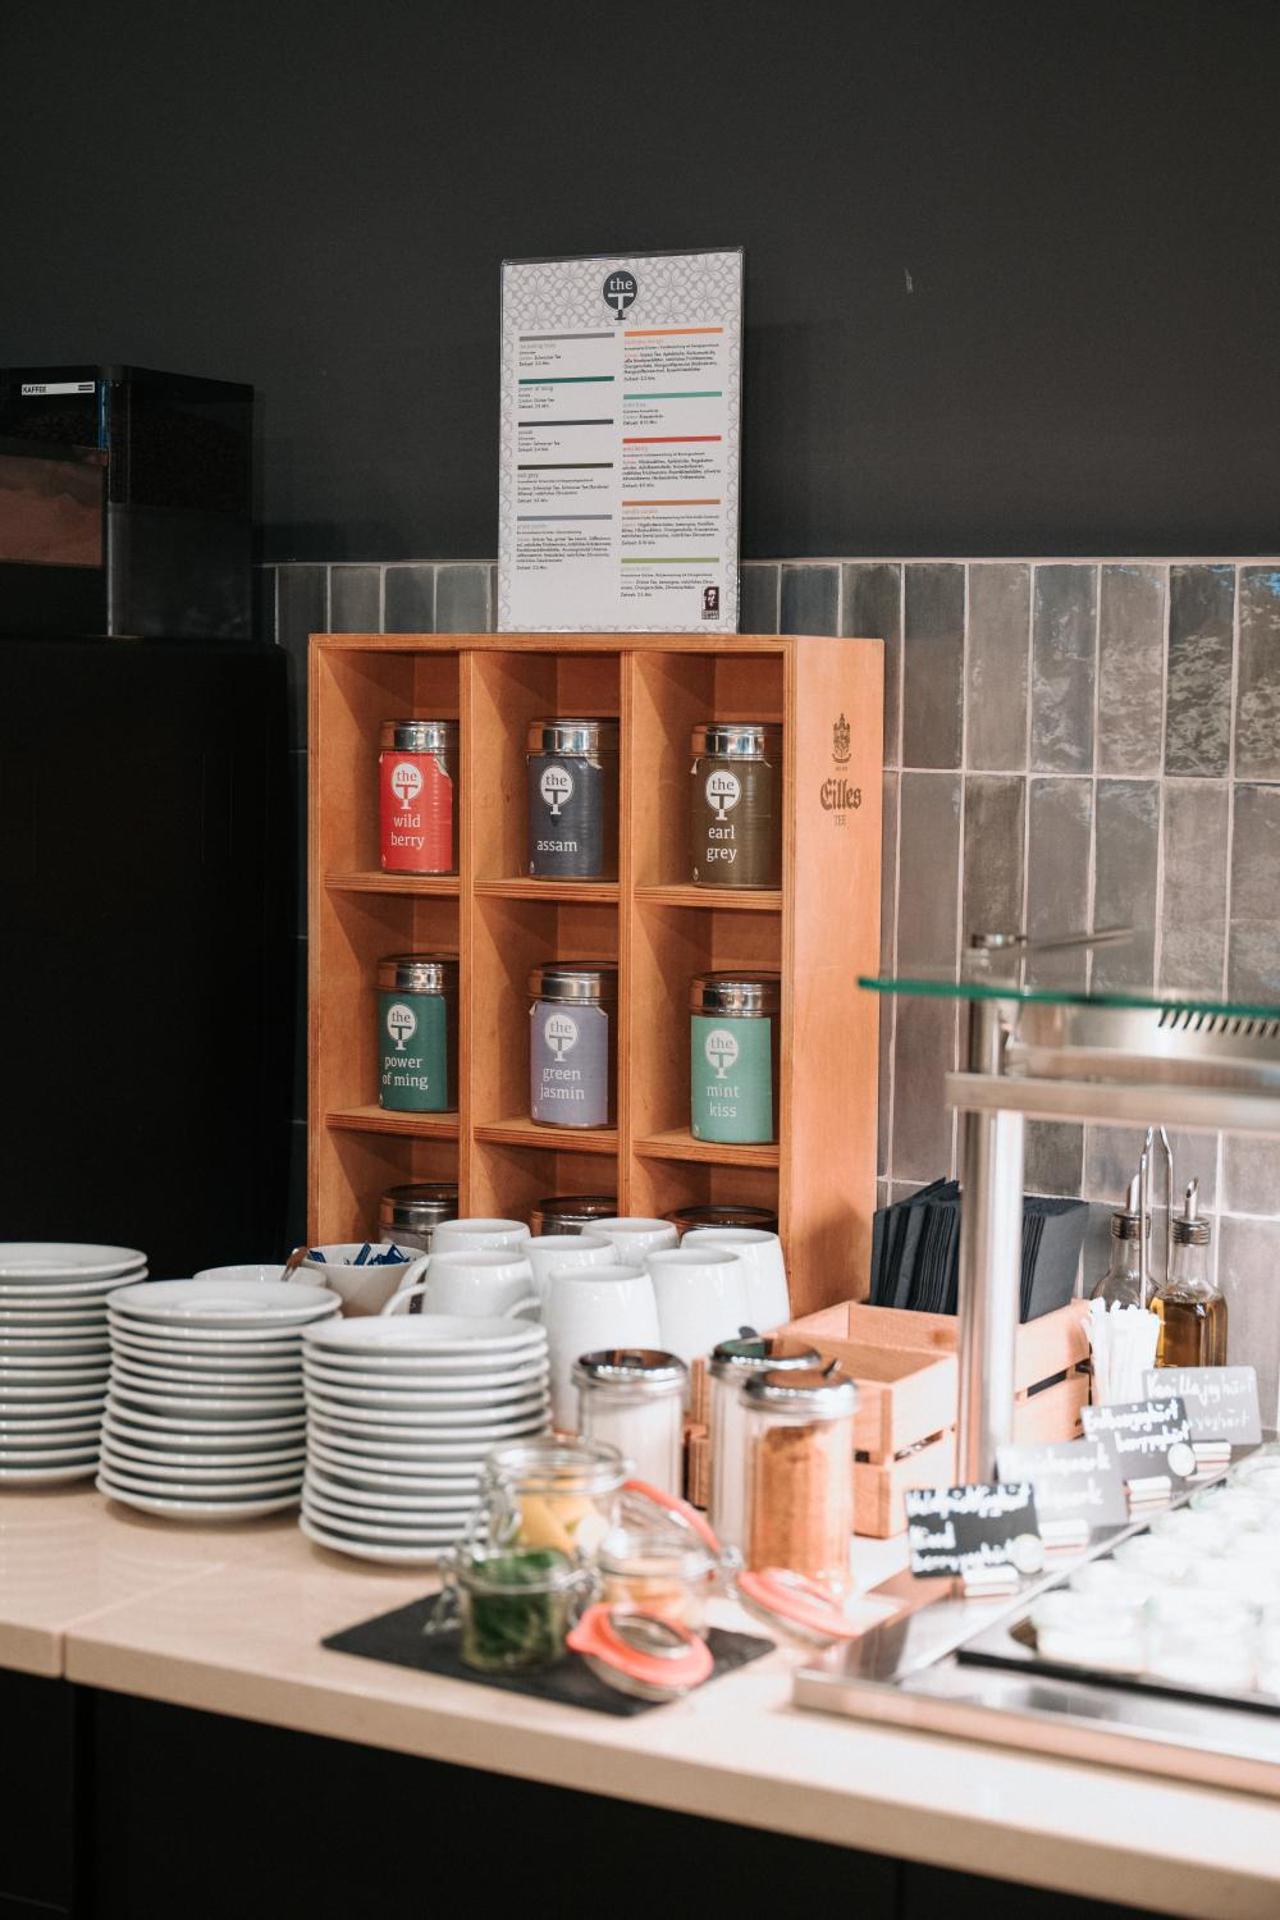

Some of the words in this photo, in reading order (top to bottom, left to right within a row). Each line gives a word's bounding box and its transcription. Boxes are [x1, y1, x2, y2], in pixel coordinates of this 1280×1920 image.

[610, 277, 634, 291] the
[22, 385, 47, 394] KAFFEE
[396, 767, 417, 783] the
[545, 773, 568, 787] the
[711, 777, 735, 791] the
[820, 778, 862, 810] Eilles
[393, 813, 421, 828] wild
[708, 825, 736, 840] earl
[390, 831, 425, 850] berry
[536, 840, 578, 853] assam
[706, 847, 737, 864] grey
[391, 1010, 412, 1024] the
[550, 1020, 572, 1034] the
[710, 1037, 734, 1051] the
[384, 1056, 424, 1071] power
[382, 1072, 393, 1086] of
[394, 1074, 429, 1091] ming
[543, 1067, 582, 1083] green
[540, 1082, 586, 1101] jasmin
[706, 1083, 741, 1099] mint
[709, 1100, 738, 1118] kiss
